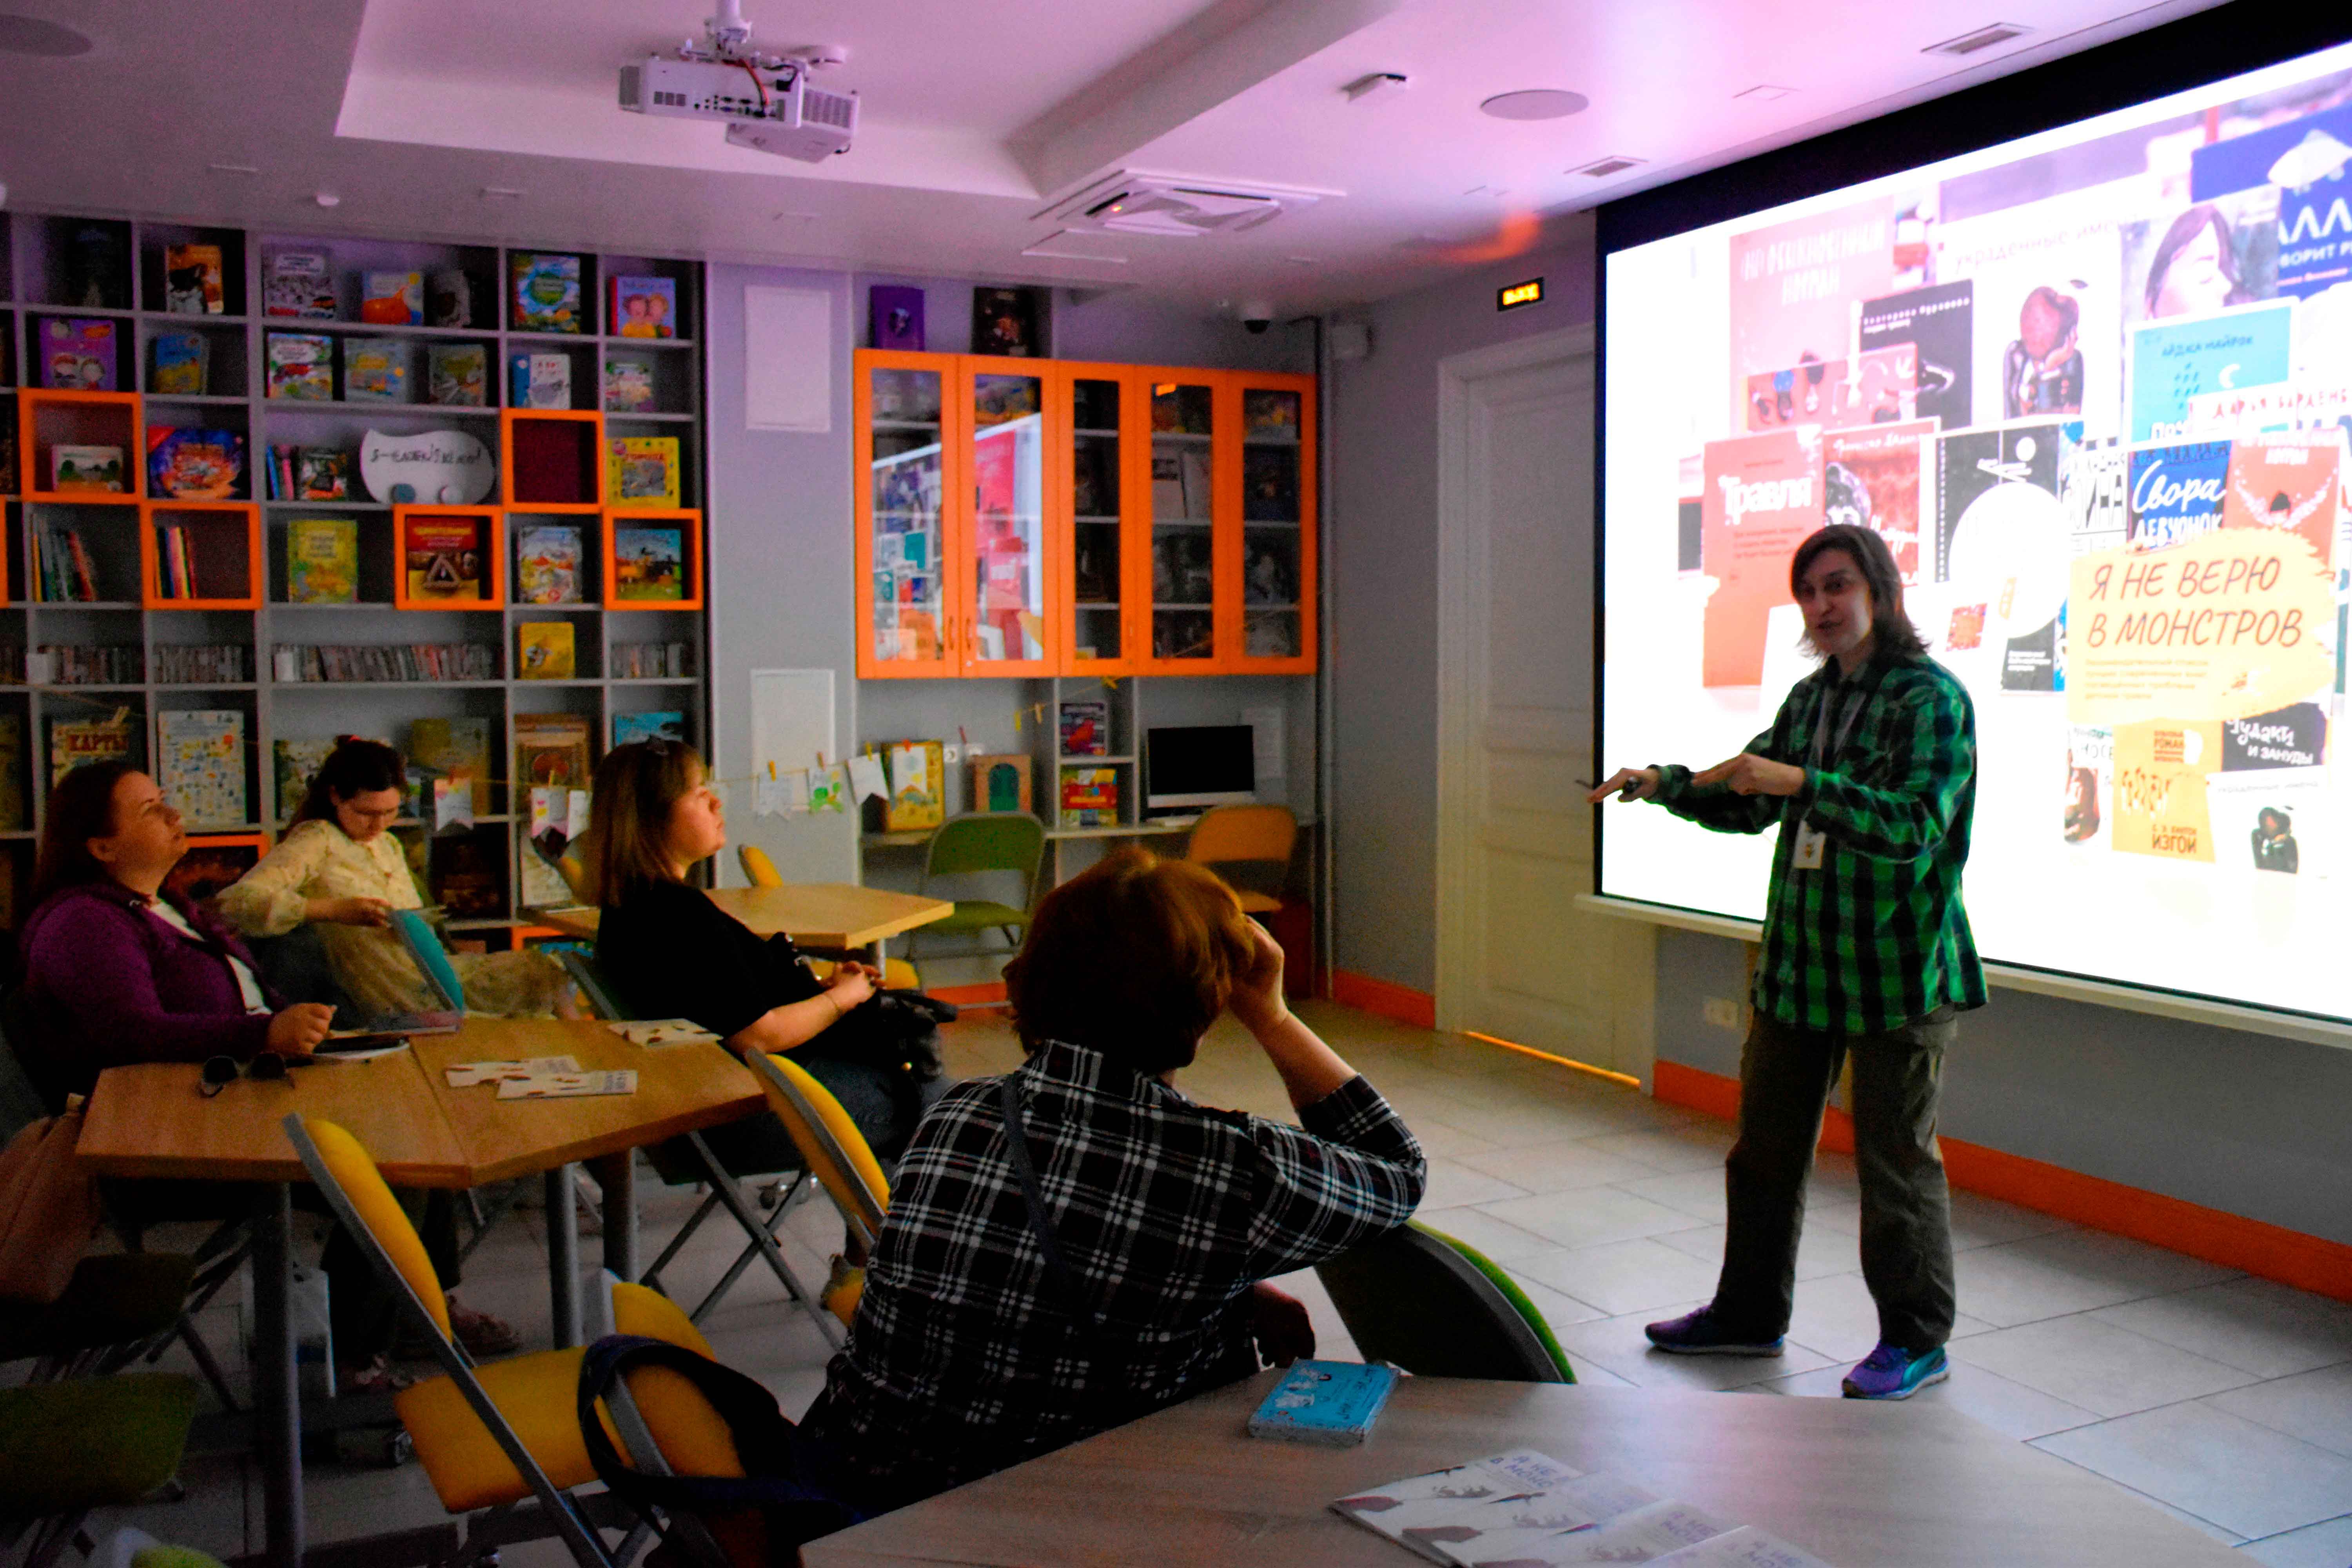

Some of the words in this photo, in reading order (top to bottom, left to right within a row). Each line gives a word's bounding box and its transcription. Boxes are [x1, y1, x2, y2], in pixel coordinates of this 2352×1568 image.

[1718, 475, 1813, 526] Травля
[2132, 459, 2227, 513] Свора
[2089, 563, 2112, 601] Я
[2120, 561, 2168, 600] НЕ
[2177, 556, 2281, 597] ВЕРЮ
[2087, 613, 2107, 648] В
[2115, 608, 2303, 648] МОНСТРОВ
[2227, 719, 2294, 746] Чудаки
[2261, 747, 2313, 764] ЗАНУДЫ
[2152, 834, 2196, 854] ИЗГОИ
